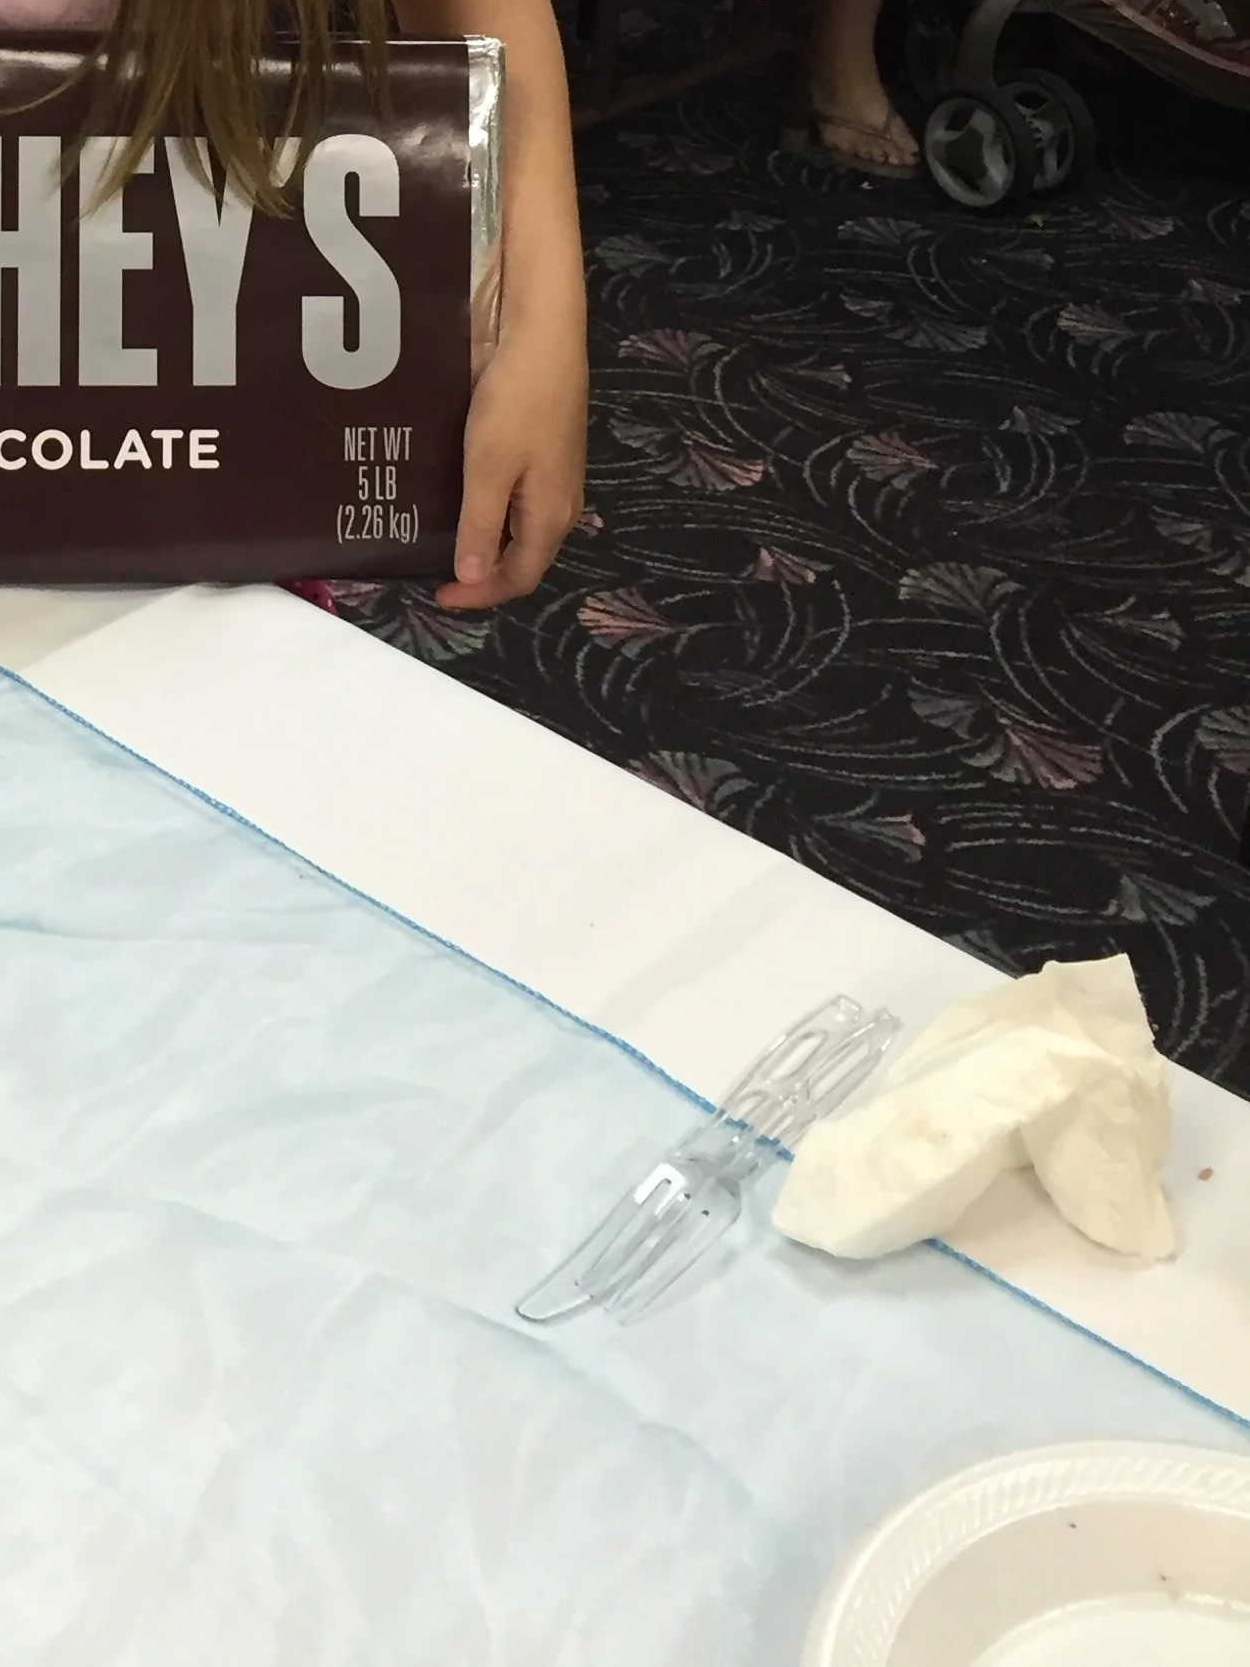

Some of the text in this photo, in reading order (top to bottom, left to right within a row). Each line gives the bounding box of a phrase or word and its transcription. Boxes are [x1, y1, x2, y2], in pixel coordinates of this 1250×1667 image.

[343, 426, 413, 462] NET WT
[358, 465, 397, 501] 5 LB
[336, 503, 420, 544] (2.26 kg)
